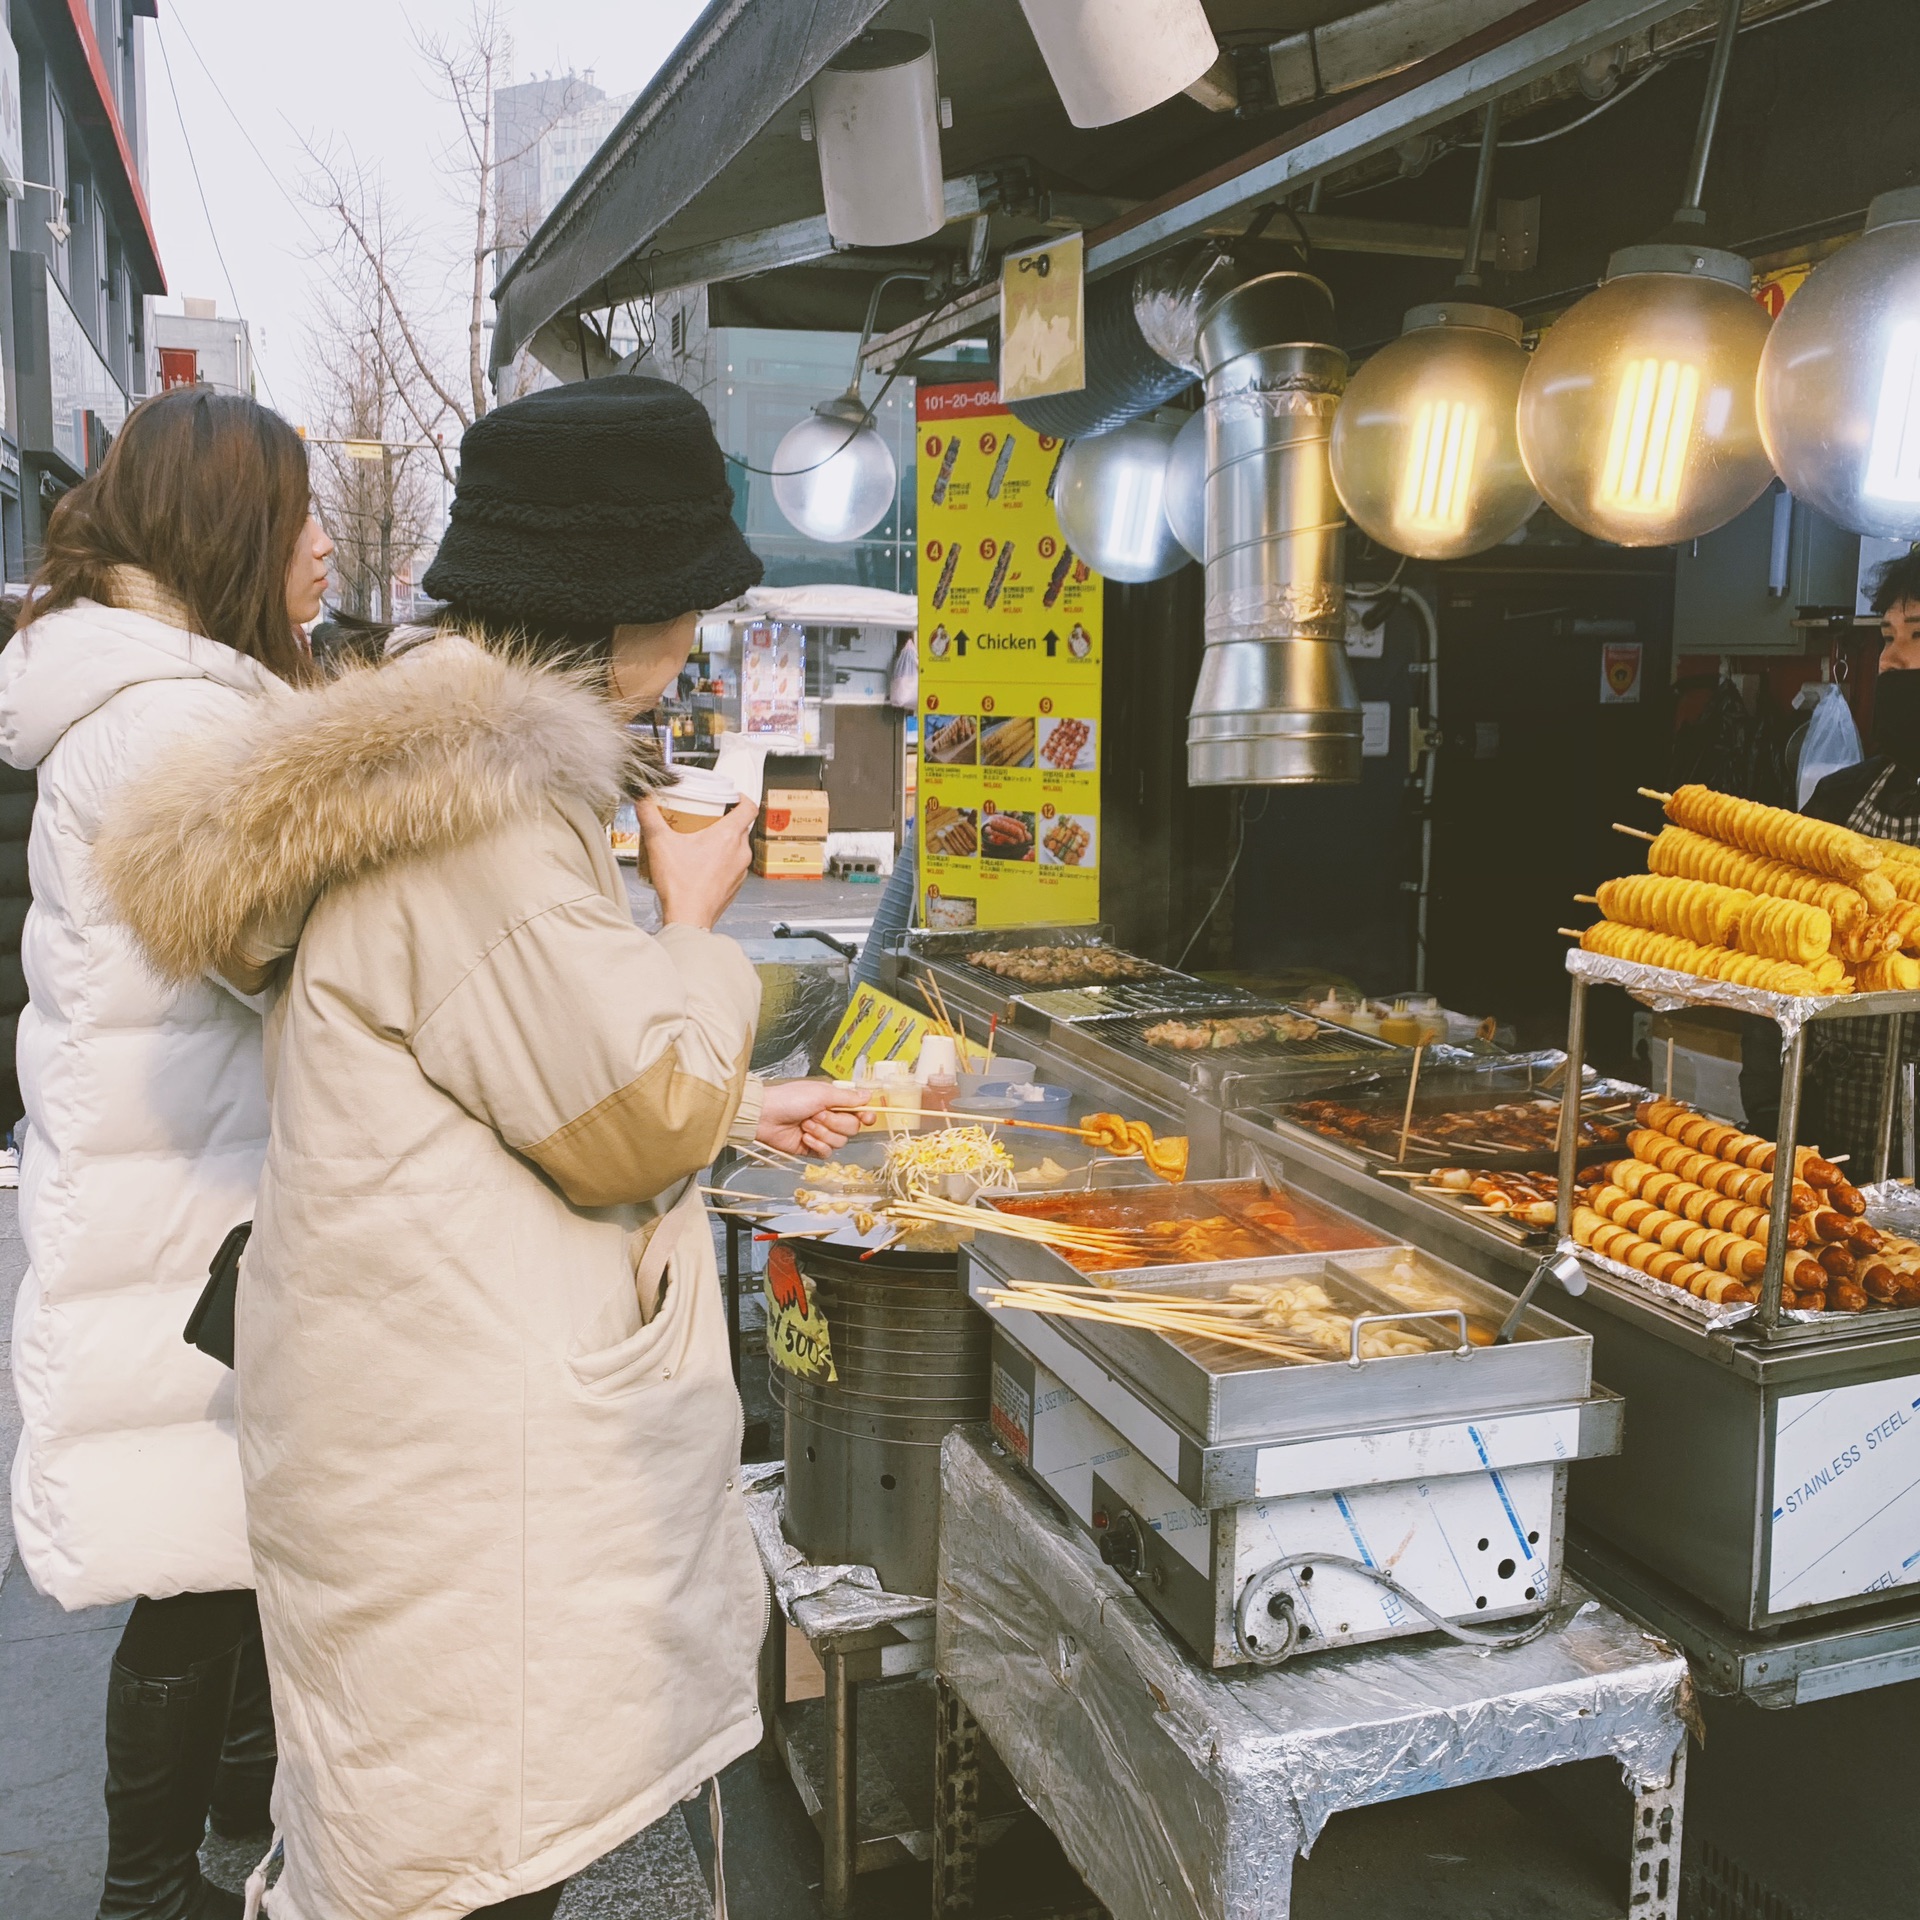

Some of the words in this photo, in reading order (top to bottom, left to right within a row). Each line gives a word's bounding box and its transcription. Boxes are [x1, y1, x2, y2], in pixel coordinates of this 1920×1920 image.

[976, 633, 1037, 650] Chicken
[929, 885, 938, 898] 13
[1786, 1444, 1861, 1513] STAINLESS
[1865, 1410, 1909, 1450] STEEL
